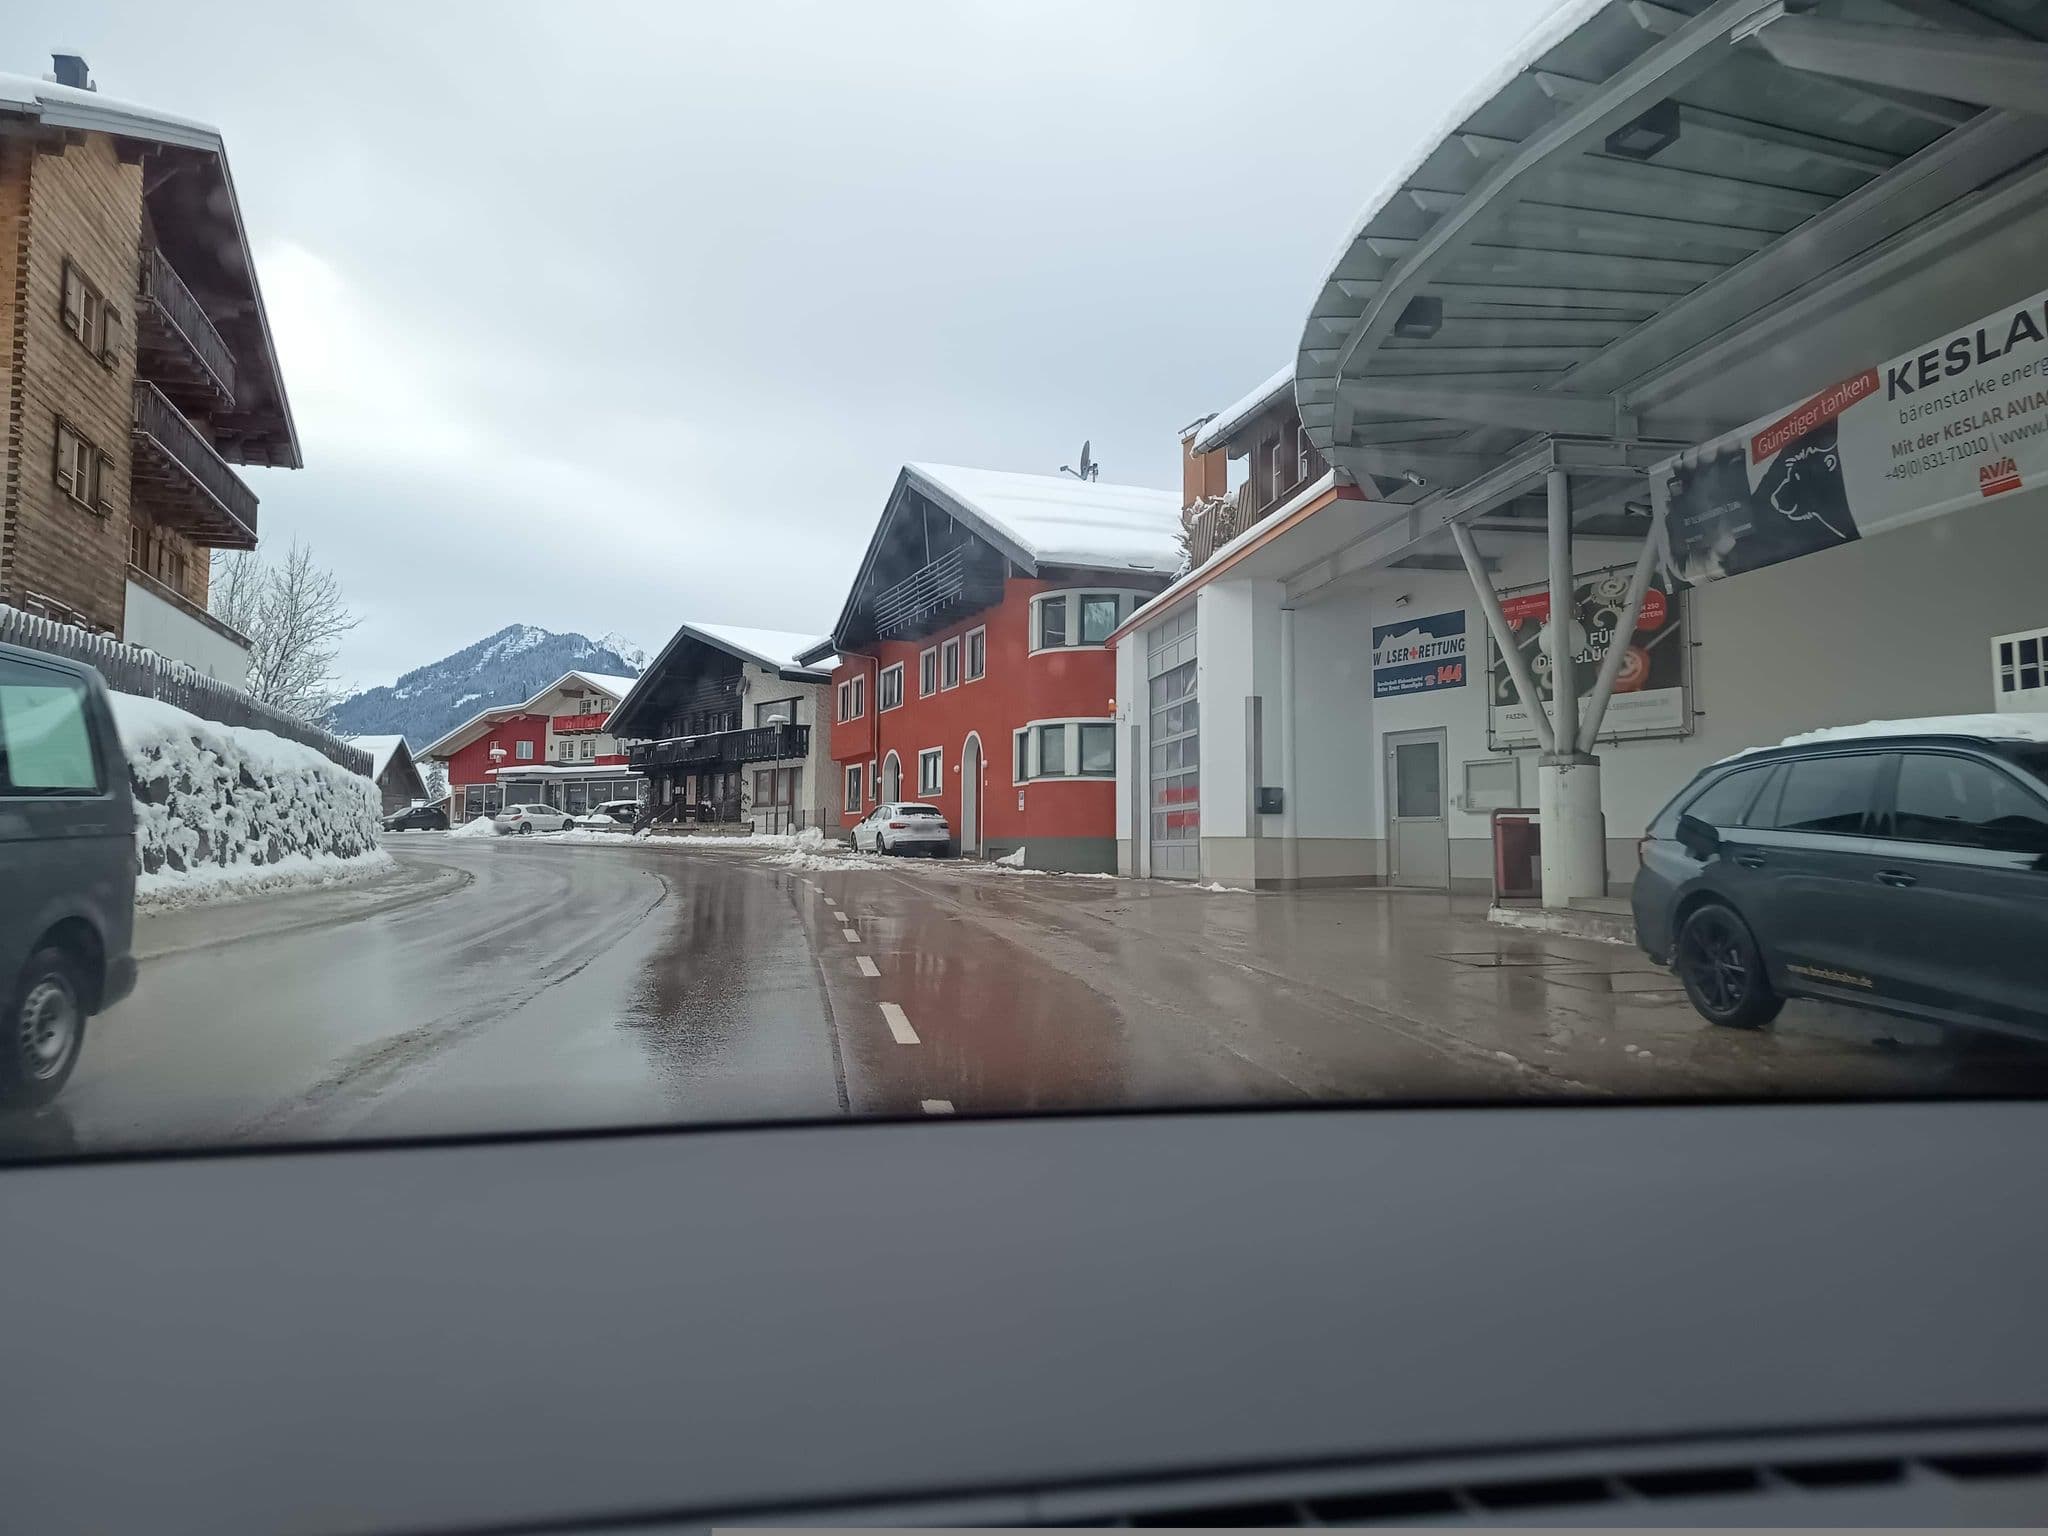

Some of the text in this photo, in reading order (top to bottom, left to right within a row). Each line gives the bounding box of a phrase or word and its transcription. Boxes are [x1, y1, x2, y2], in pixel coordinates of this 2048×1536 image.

[1888, 300, 2048, 401] KESLA
[1758, 375, 1870, 454] Günstiger tanken
[1891, 389, 2048, 459] Mit der KESLAR AVIA
[1899, 378, 1996, 425] bärenstarke
[1979, 456, 2018, 482] AVIA
[1373, 638, 1466, 666] WLSER RETTUNG
[1437, 664, 1462, 684] 144
